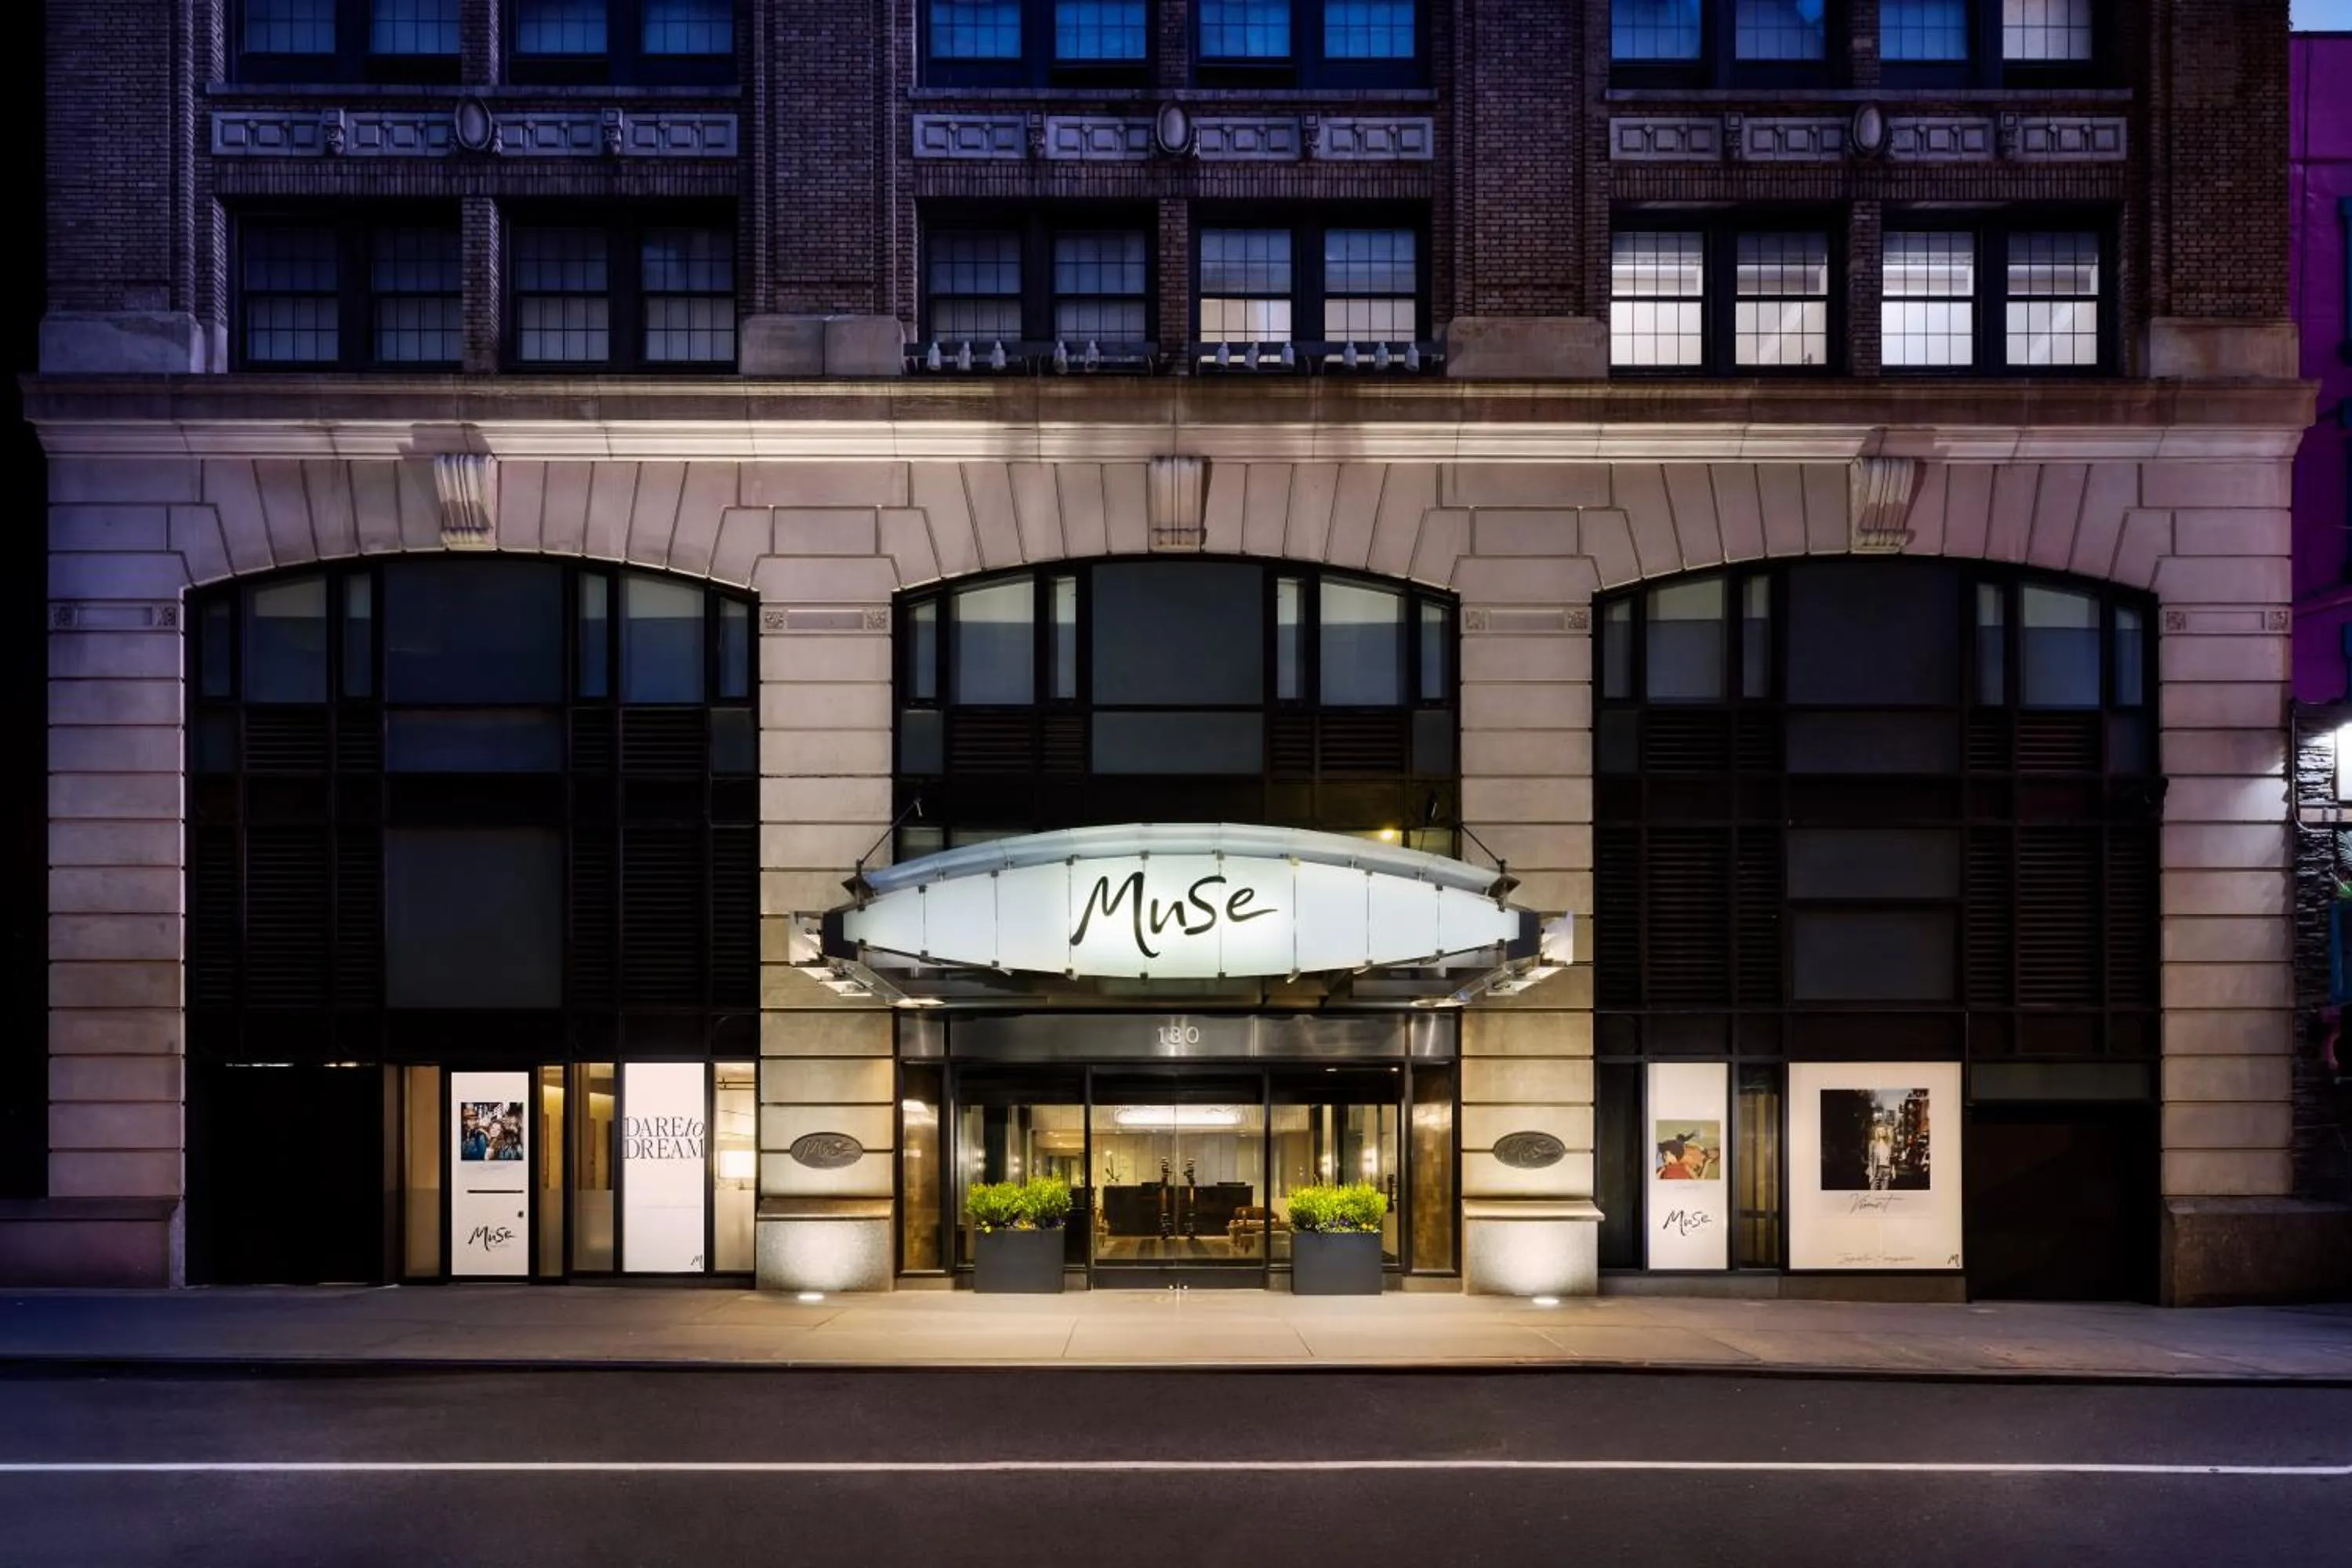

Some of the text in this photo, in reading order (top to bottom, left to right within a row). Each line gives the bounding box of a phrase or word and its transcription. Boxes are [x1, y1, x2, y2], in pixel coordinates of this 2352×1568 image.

[1156, 1026, 1200, 1044] 180
[623, 1116, 705, 1138] DARE to
[622, 1138, 705, 1160] DREAM
